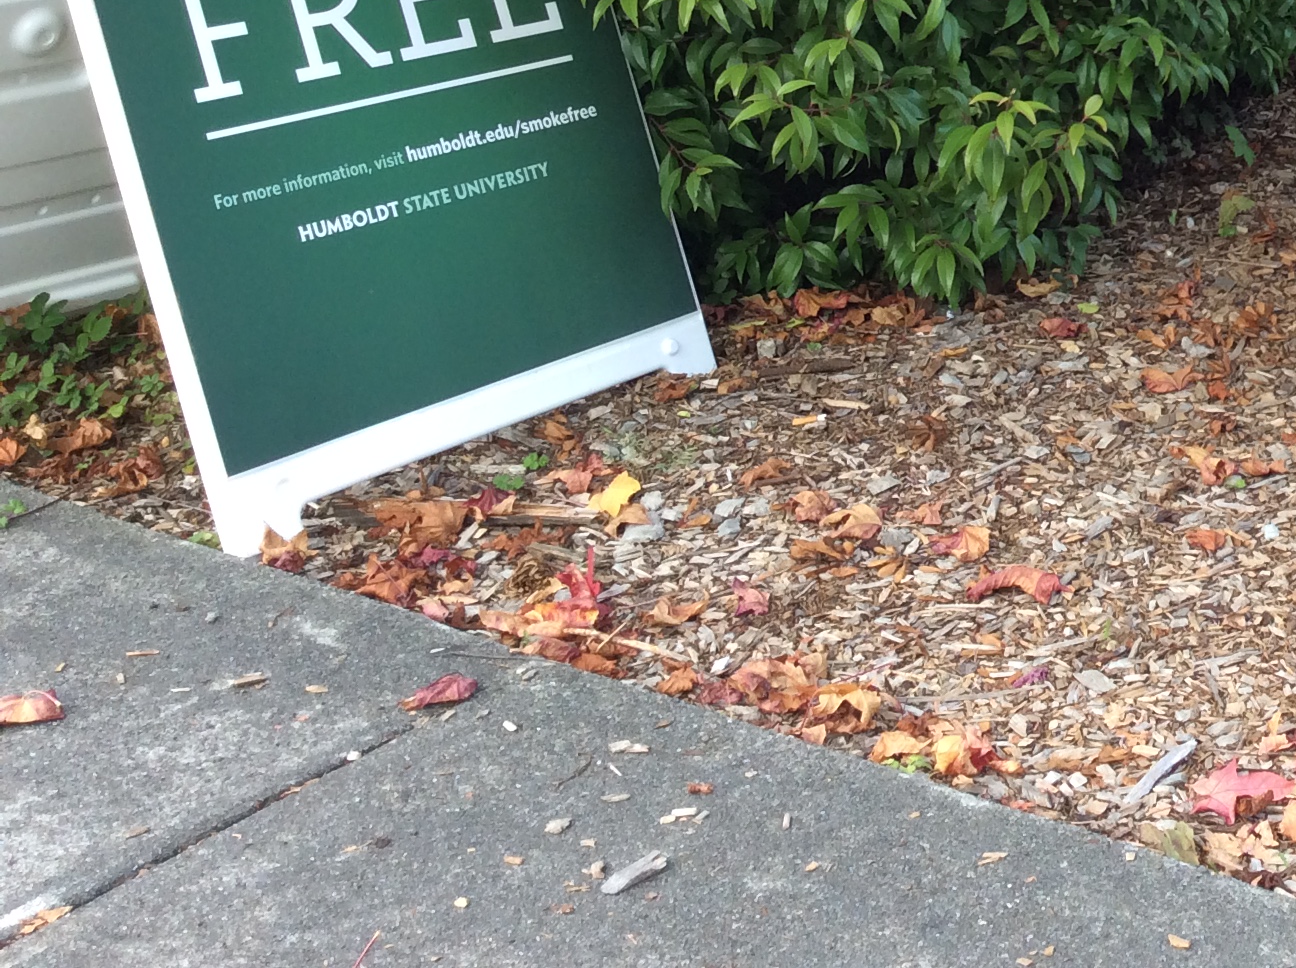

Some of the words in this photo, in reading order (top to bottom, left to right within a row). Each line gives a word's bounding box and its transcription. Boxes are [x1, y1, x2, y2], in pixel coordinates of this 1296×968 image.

[213, 192, 240, 212] For
[242, 181, 282, 204] more
[283, 159, 373, 194] information,
[374, 151, 404, 171] visit
[405, 104, 599, 163] humboldt.edu/smokefree
[298, 200, 400, 243] HUMBOLDT
[402, 188, 452, 215] STATE
[453, 161, 550, 201] UNIVERSITY
